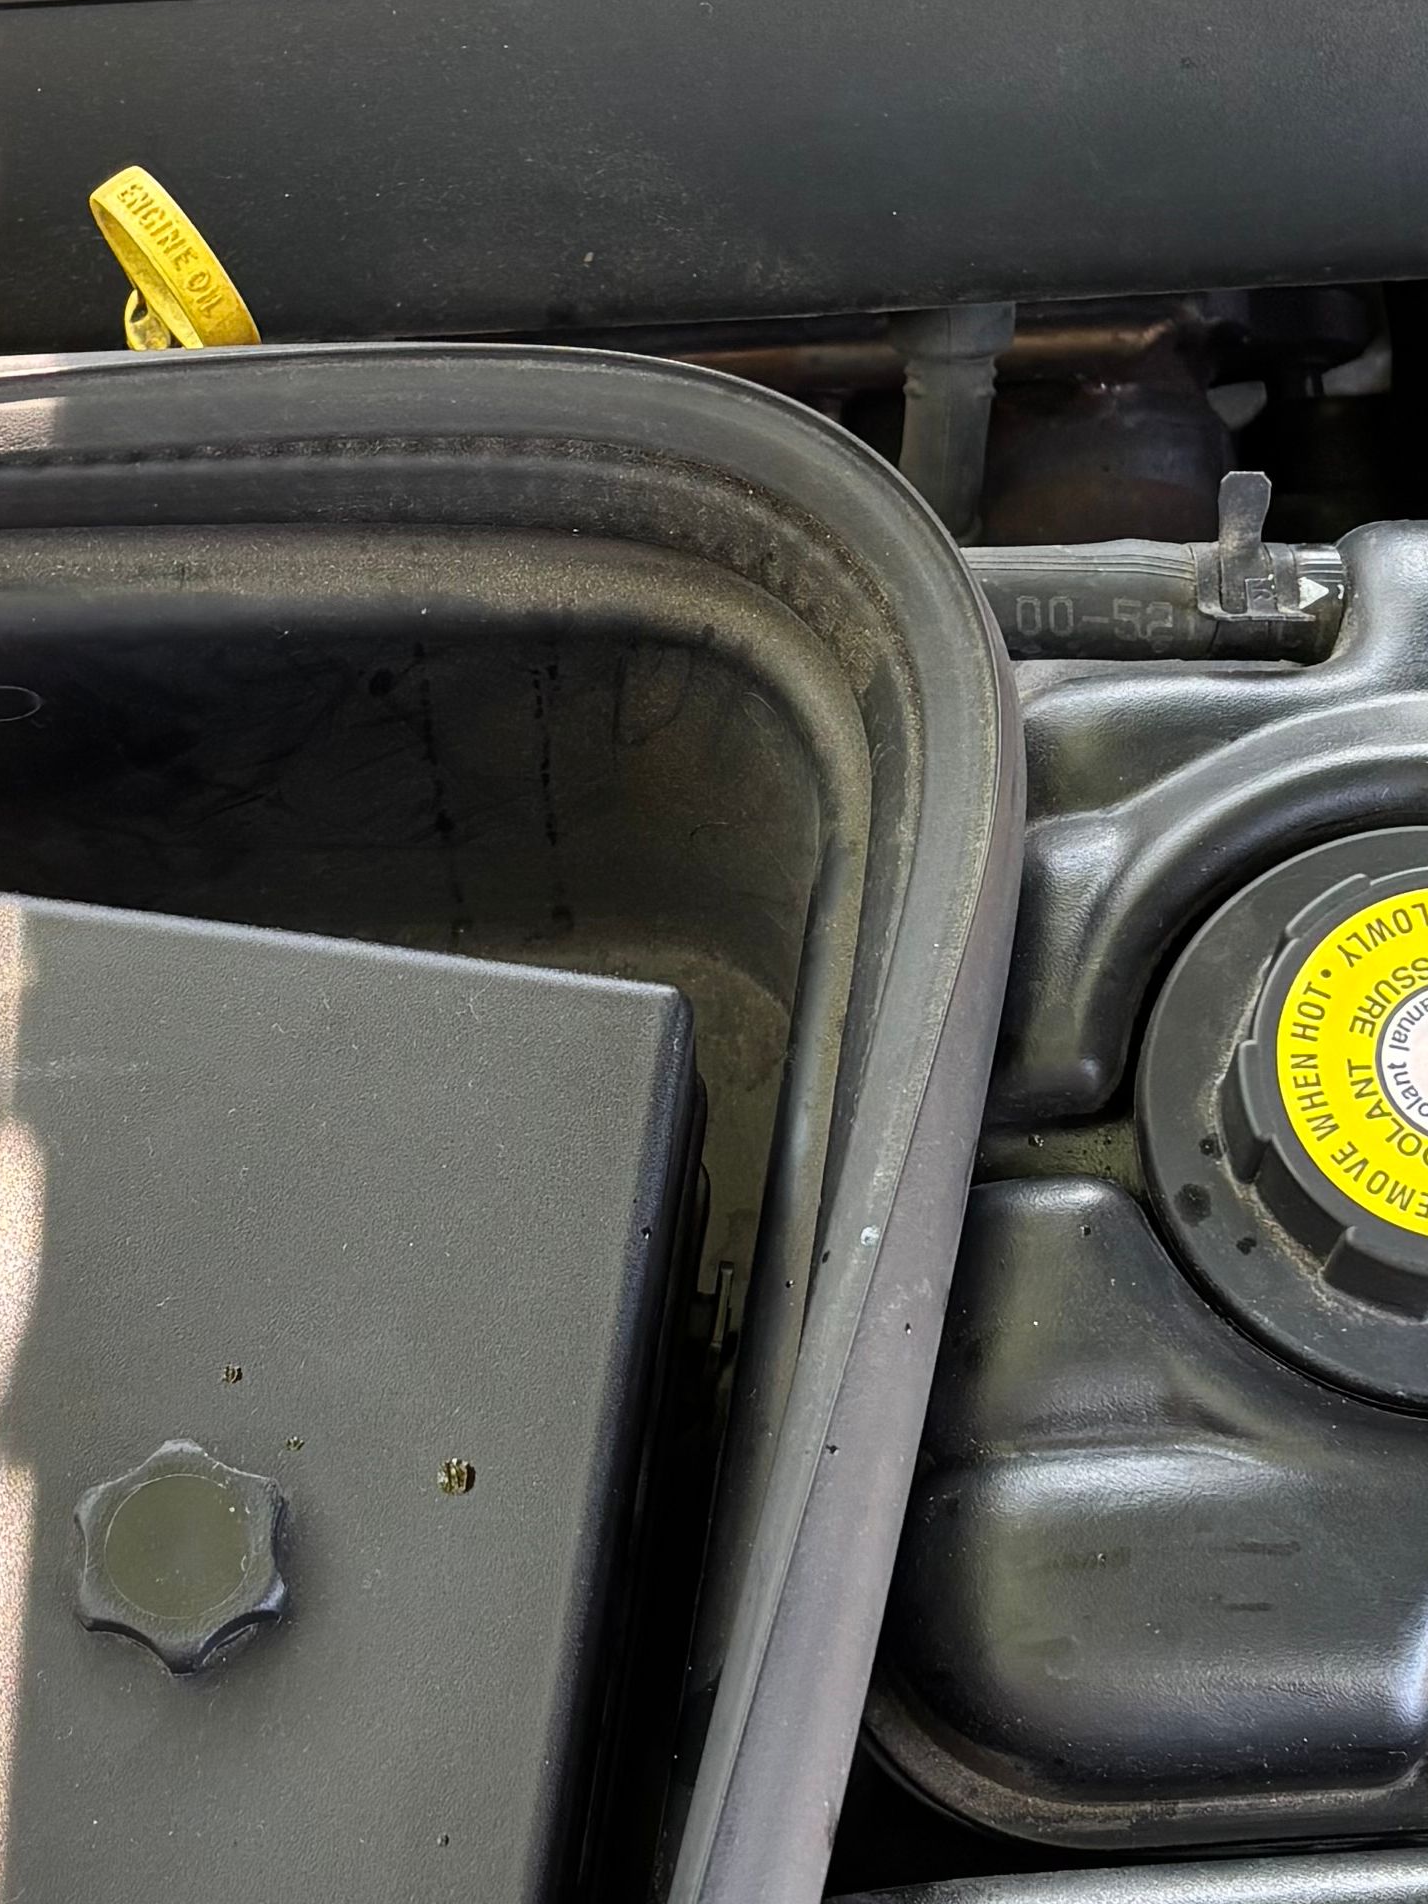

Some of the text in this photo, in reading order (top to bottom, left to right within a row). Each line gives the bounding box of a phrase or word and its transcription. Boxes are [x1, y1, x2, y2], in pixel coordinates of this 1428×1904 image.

[116, 183, 224, 319] ENGINE OIL
[1289, 980, 1332, 1042] HOT
[1289, 1052, 1341, 1142] WHEN
